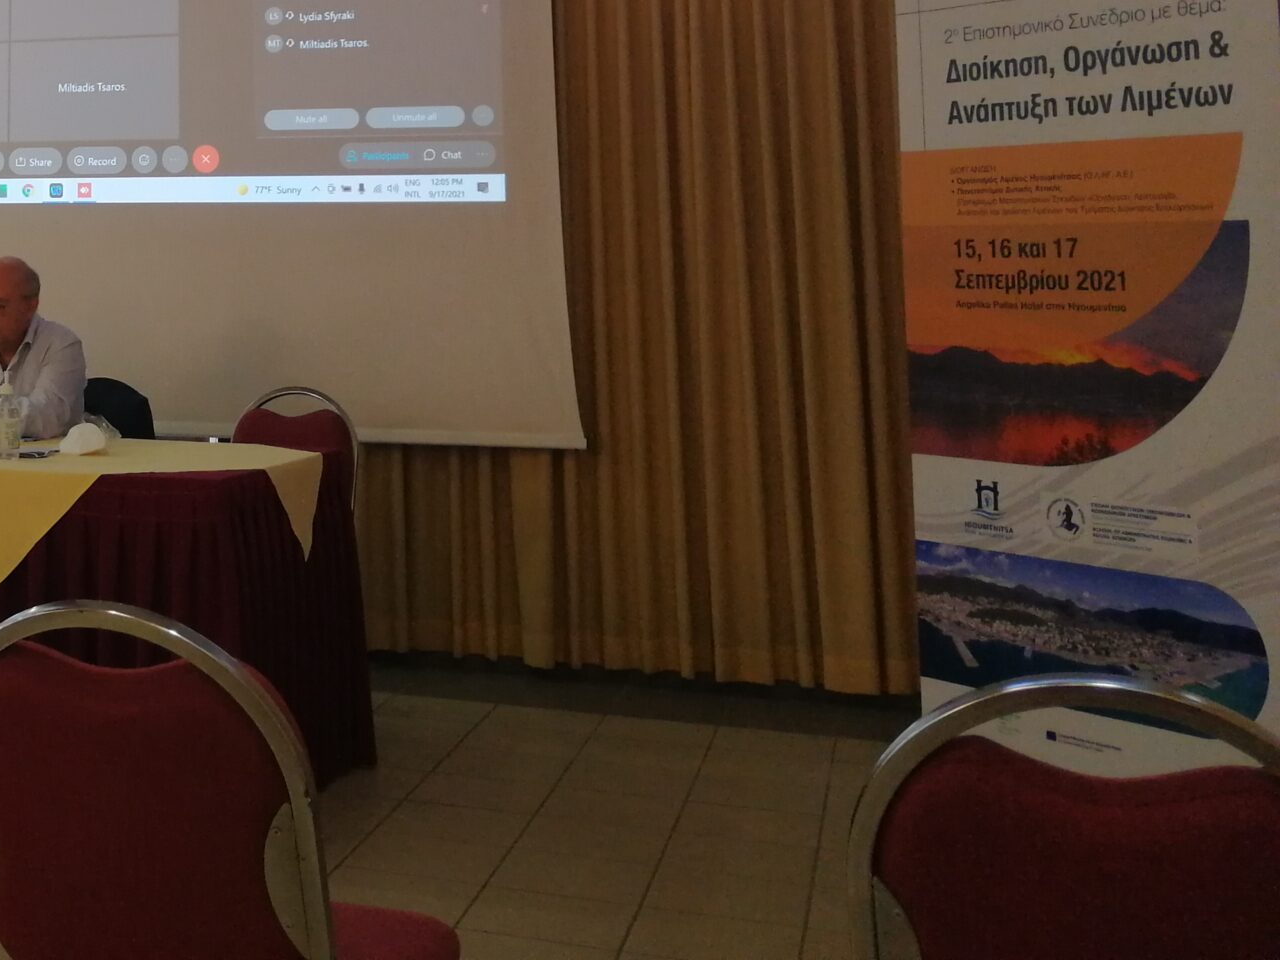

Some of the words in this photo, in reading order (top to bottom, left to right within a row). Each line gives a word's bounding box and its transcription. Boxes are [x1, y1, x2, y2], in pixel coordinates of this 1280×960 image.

[299, 12, 323, 24] Lydia
[324, 10, 355, 23] Sfyraki
[963, 17, 1064, 42] Επιστημονικό
[1068, 7, 1146, 31] Συνέδριο
[1150, 5, 1172, 23] με
[300, 39, 338, 49] Miltiadis
[946, 53, 1055, 83] Διοίκηση,
[1063, 39, 1200, 76] Οργάνωση
[1209, 30, 1229, 58] &
[58, 82, 95, 93] Miltiadis
[948, 93, 1058, 125] Ανάπτυξη
[1066, 92, 1112, 117] των
[1120, 82, 1234, 117] Λιμένων
[295, 114, 317, 124] Mute
[318, 114, 328, 123] all
[392, 112, 425, 122] Unmute
[427, 112, 437, 121] all
[441, 149, 462, 160] Chat
[29, 156, 52, 167] Share
[88, 156, 117, 167] Record
[404, 178, 421, 187] ENG
[431, 178, 449, 187] 12:05
[450, 178, 463, 186] PM
[277, 185, 302, 197] Sunny
[404, 190, 421, 199] INTL
[428, 190, 465, 199] 9/17/2021
[953, 238, 982, 262] 15,
[988, 239, 1012, 259] 16
[1018, 239, 1047, 258] και
[1052, 237, 1078, 258] 17
[954, 269, 1069, 295] Σεπτεμβρίου
[1076, 270, 1127, 291] 2021
